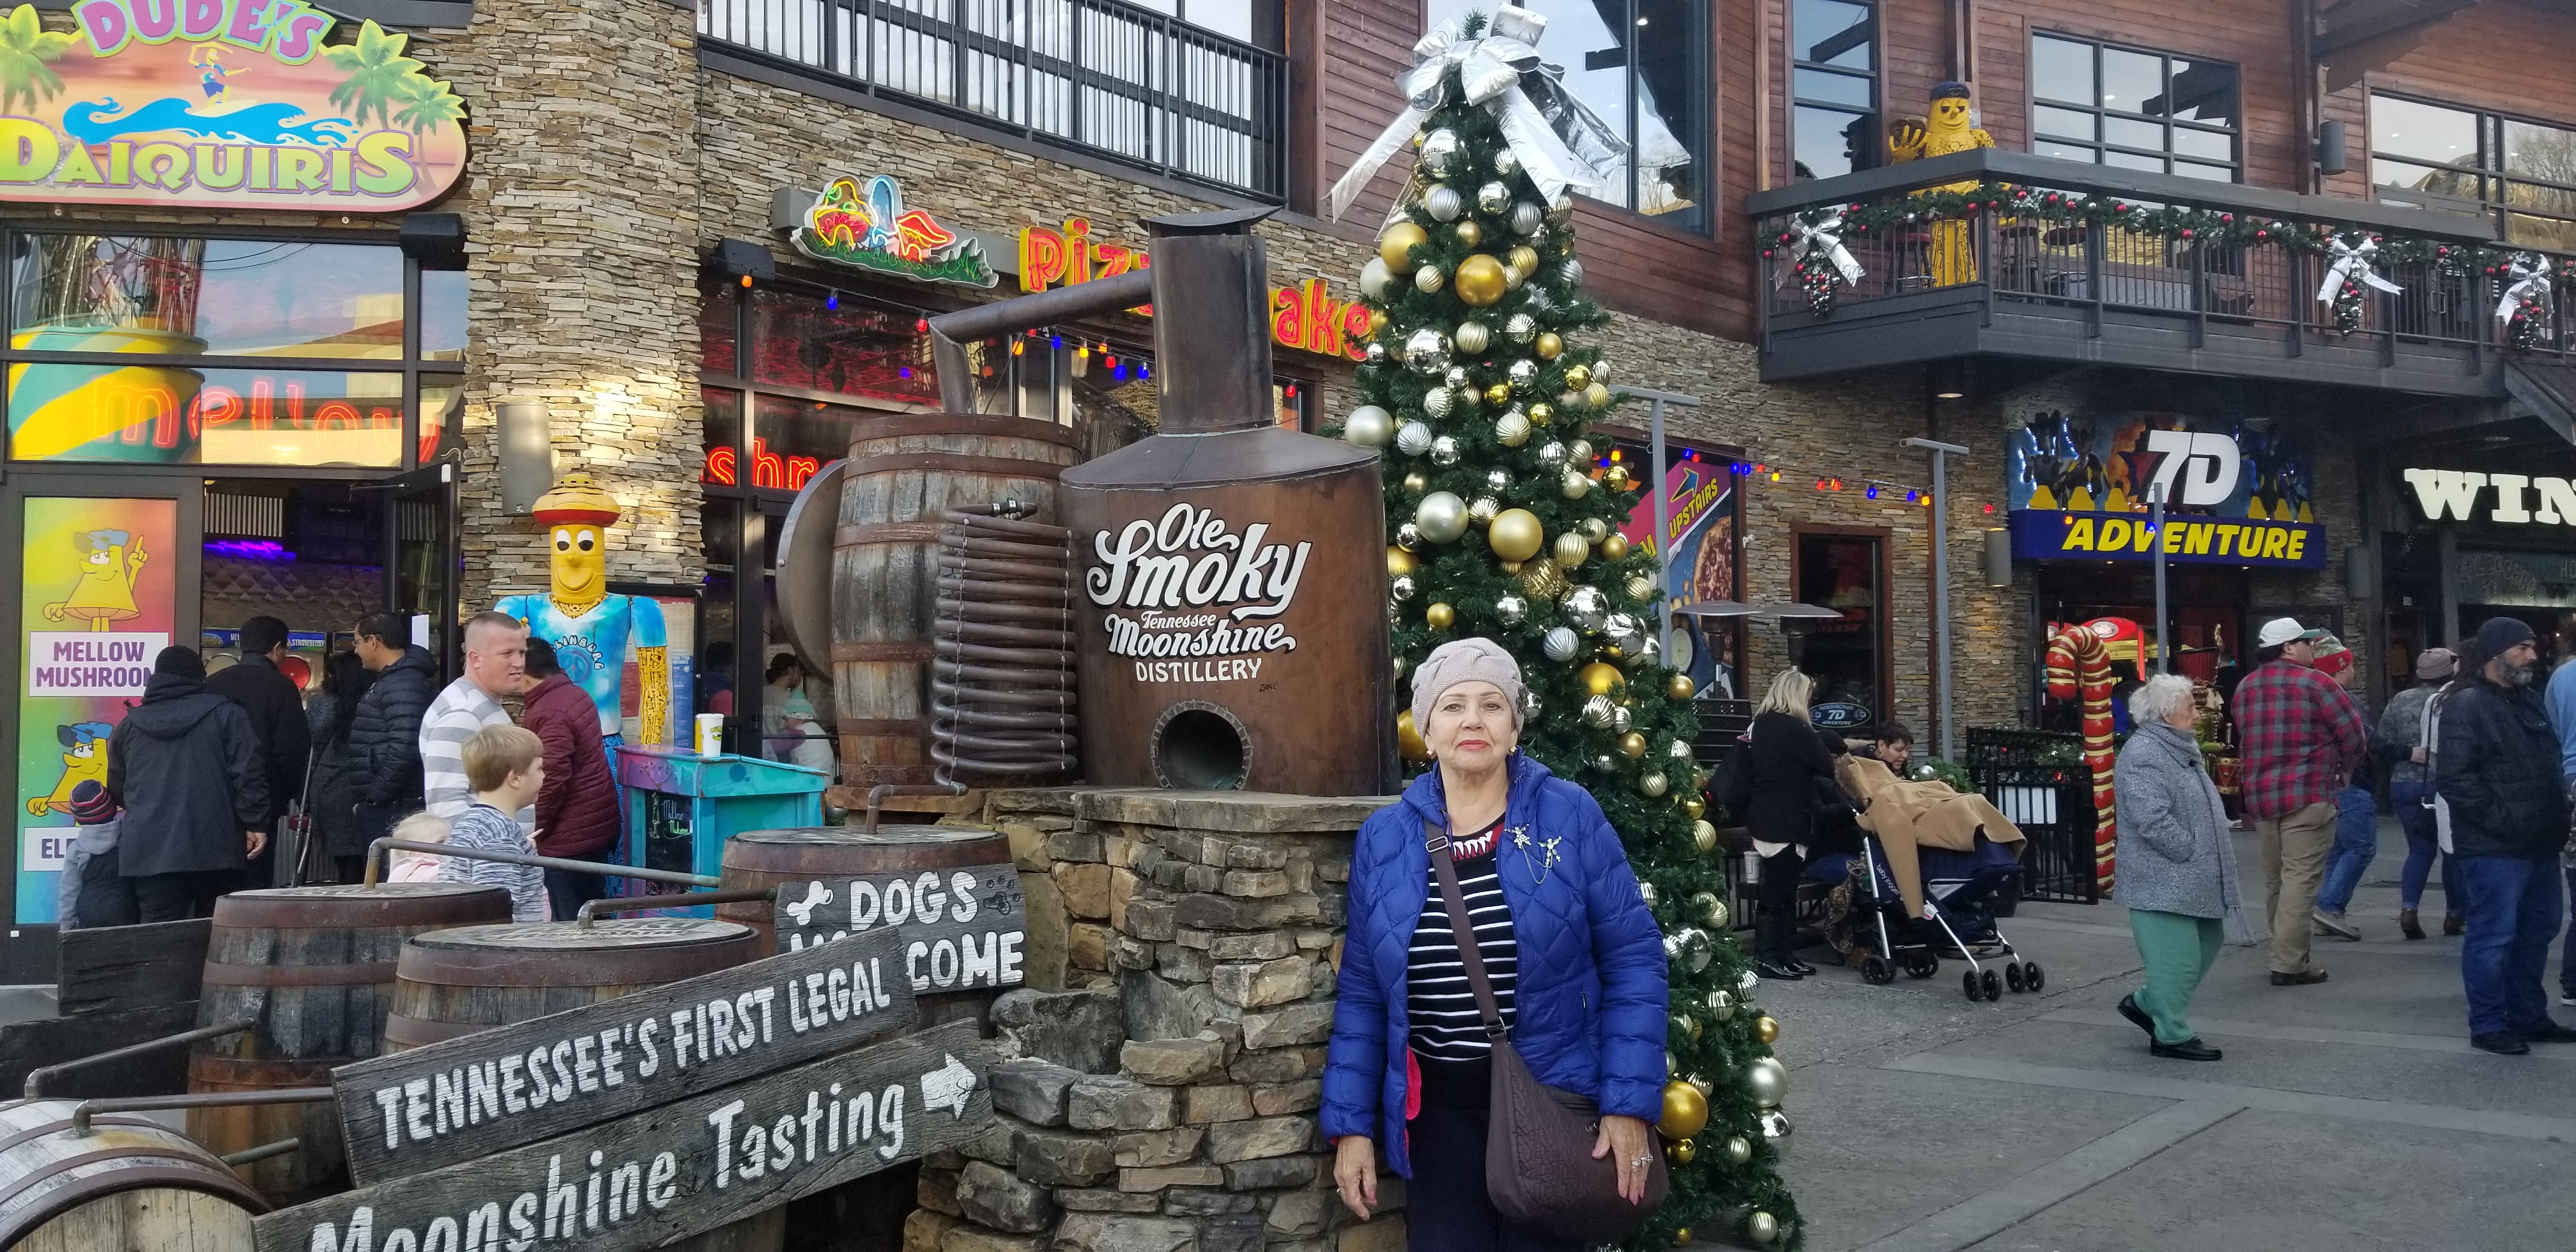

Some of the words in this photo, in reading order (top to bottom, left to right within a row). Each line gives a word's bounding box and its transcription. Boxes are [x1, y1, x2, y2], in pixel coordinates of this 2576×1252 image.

[79, 0, 327, 57] DUDE'S
[0, 118, 417, 194] DAIQUIRIS
[1019, 217, 1153, 317] Piz
[1268, 279, 1373, 362] ake
[700, 436, 838, 490] shr
[2147, 430, 2240, 505] 7D
[1669, 478, 1718, 539] UPSTAIRS
[2404, 468, 2576, 526] WIN
[1157, 503, 1240, 552] Ole
[2062, 518, 2307, 560] ADVENTURE
[1086, 519, 1312, 621] Smoky
[1105, 613, 1297, 657] Moonshine
[1141, 610, 1216, 629] Tennessee
[54, 641, 144, 662] MELLOW
[553, 635, 604, 669] LINBURG
[1135, 657, 1262, 682] DISTILLERY
[1828, 710, 1845, 720] 7D
[1876, 864, 1887, 879] baby
[1884, 878, 1901, 895] jogger
[850, 871, 977, 931] DOGS
[906, 931, 1023, 990] COME
[376, 1017, 658, 1149] TENNESSEE'S
[671, 986, 774, 1069] FIRST
[788, 957, 891, 1033] LEGAL
[312, 1150, 677, 1252] Moonshine
[709, 1083, 905, 1189] Tasting
